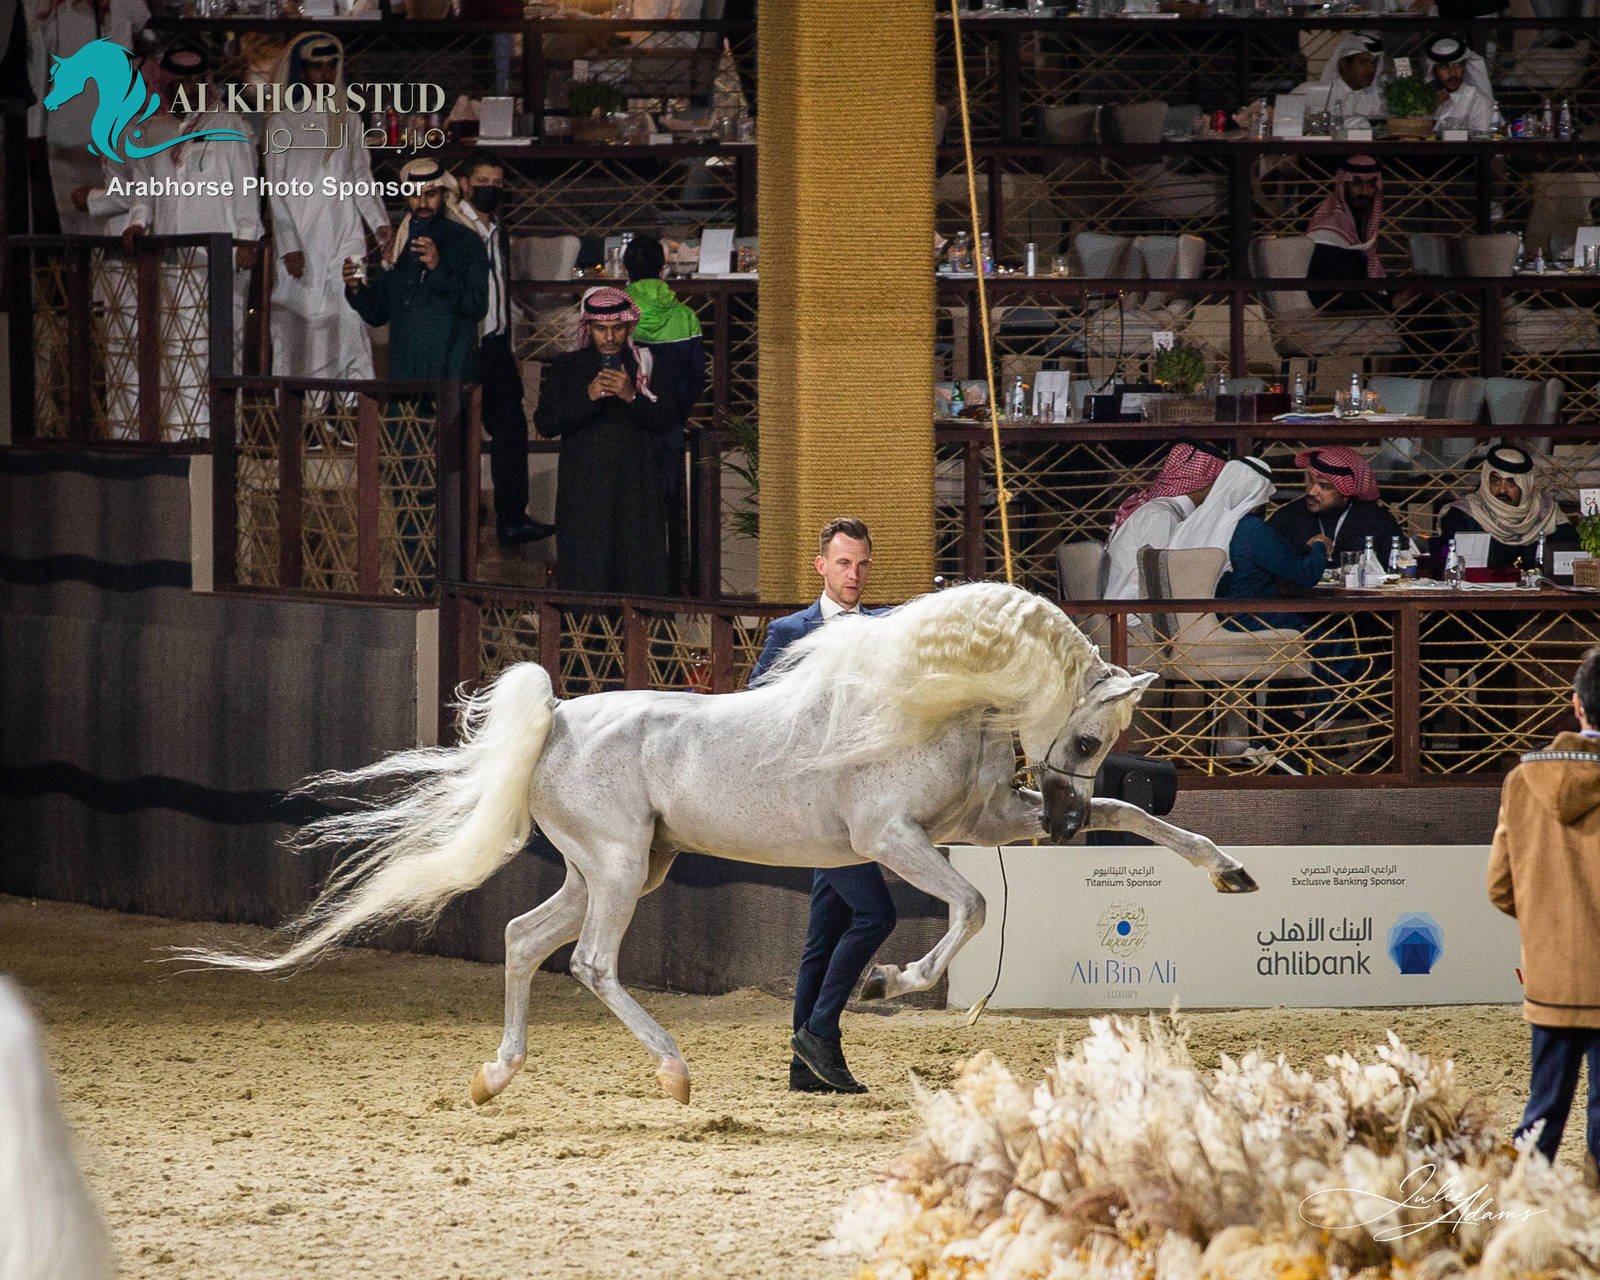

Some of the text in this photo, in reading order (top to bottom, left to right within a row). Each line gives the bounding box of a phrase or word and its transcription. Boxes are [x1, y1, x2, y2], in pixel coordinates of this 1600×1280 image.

[1128, 866, 1155, 877] الراعي
[1300, 865, 1397, 876] الراعي المصرفي الحصري
[1085, 878, 1162, 888] Titanium Sponsor
[1291, 877, 1406, 888] Exclusive Banking Sponsor
[1257, 917, 1372, 952] البنك الأهلي
[1256, 950, 1372, 976] ahlibank
[1070, 960, 1176, 984] Ali Bin Ali
[1107, 990, 1139, 999] LUXURY
